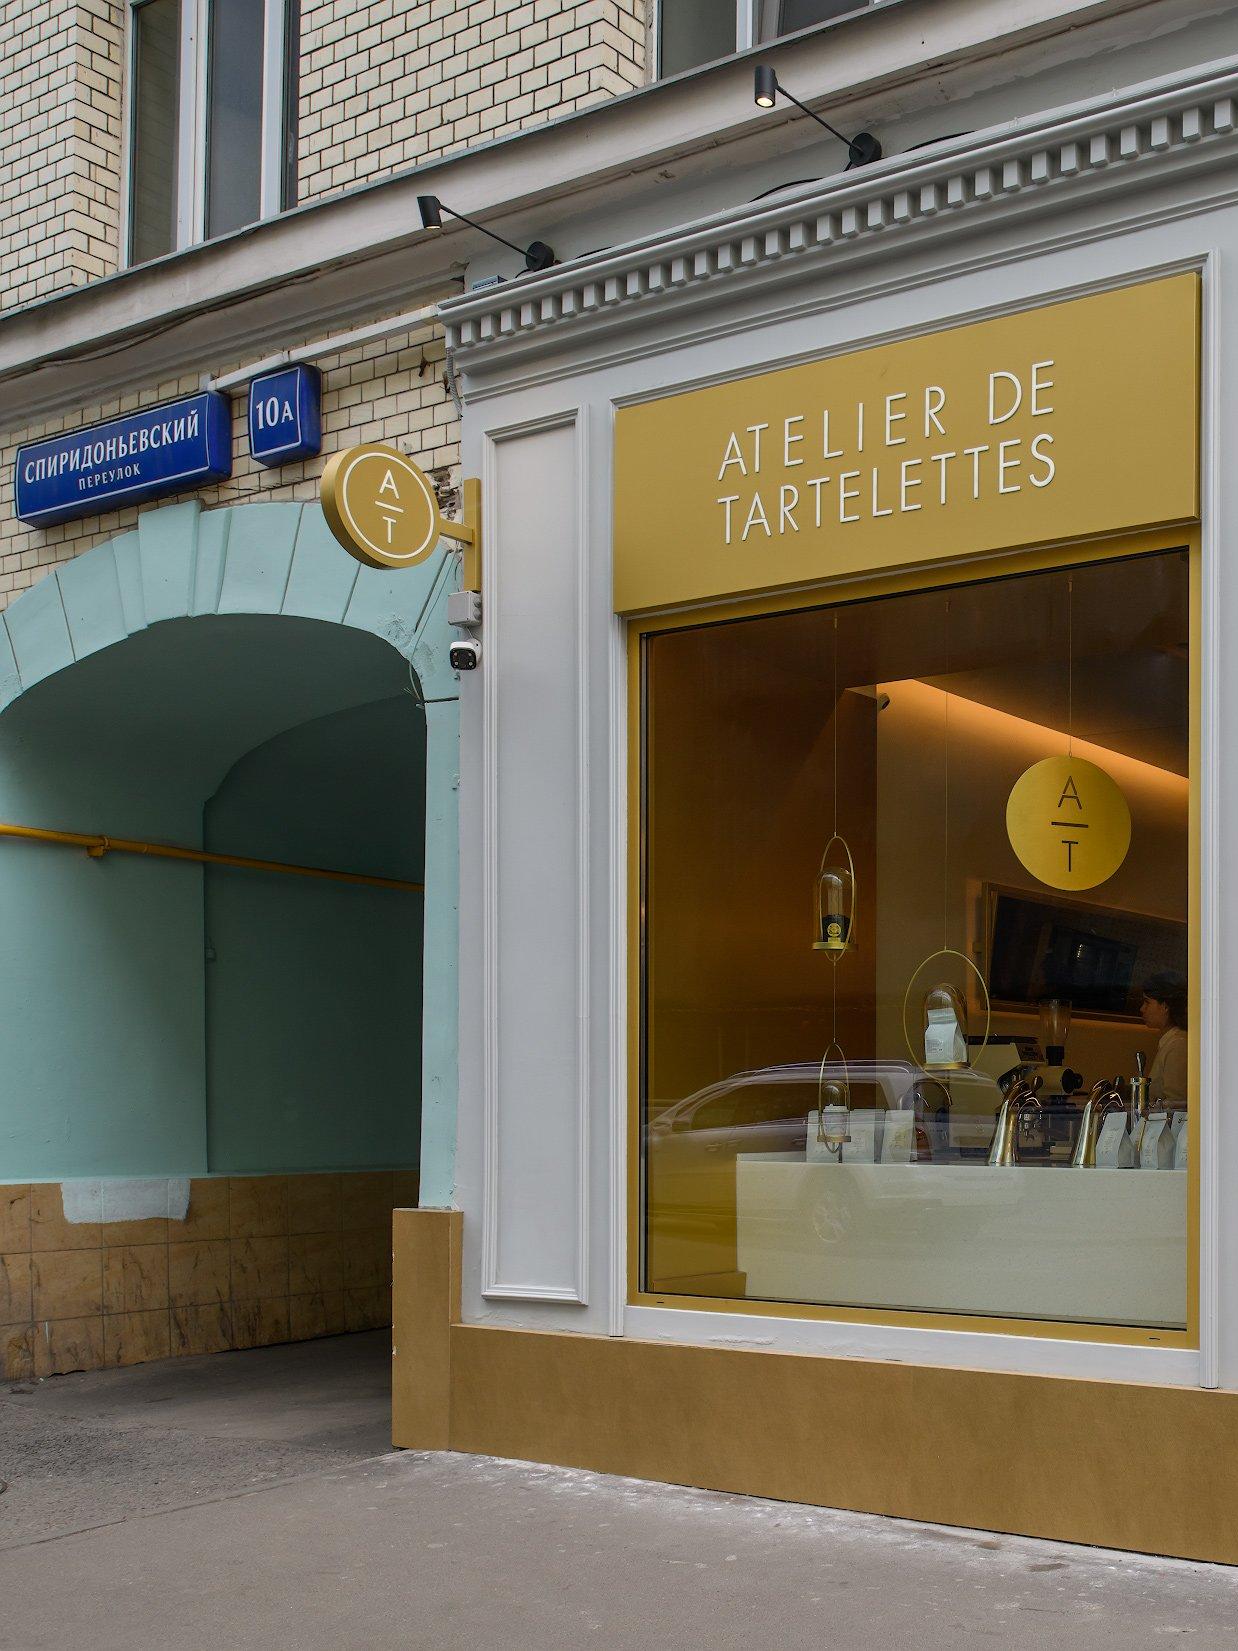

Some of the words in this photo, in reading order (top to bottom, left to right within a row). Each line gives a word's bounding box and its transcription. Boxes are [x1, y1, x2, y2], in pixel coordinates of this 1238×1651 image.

[255, 396, 294, 431] 10А
[717, 385, 946, 481] ATELIER
[988, 360, 1055, 426] DE
[24, 408, 200, 485] СПИРИДОНЬЕВСКИЙ
[78, 462, 141, 492] ПЕРЕУЛОК
[379, 468, 400, 500] A
[716, 432, 1056, 545] TARTELETTES
[382, 515, 398, 544] T
[1057, 775, 1083, 810] A
[1061, 839, 1079, 873] T
